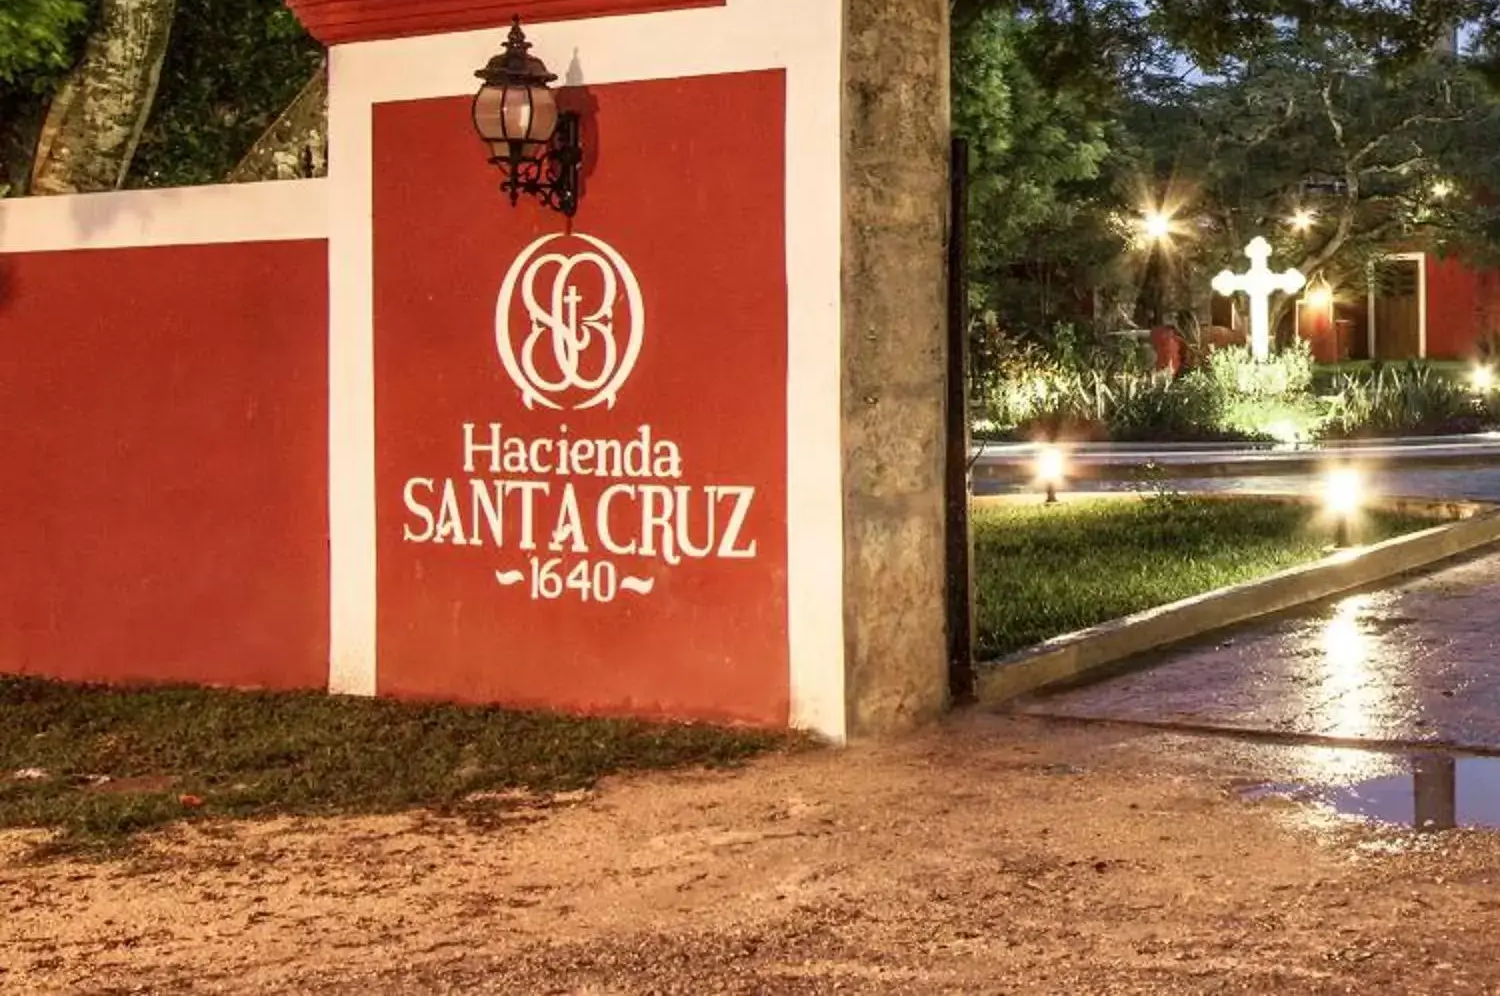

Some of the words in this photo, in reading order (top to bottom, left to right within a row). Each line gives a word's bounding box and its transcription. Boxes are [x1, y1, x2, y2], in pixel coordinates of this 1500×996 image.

[461, 421, 683, 479] Hacienda
[402, 476, 590, 554] SANTA
[595, 482, 758, 566] CRUZ
